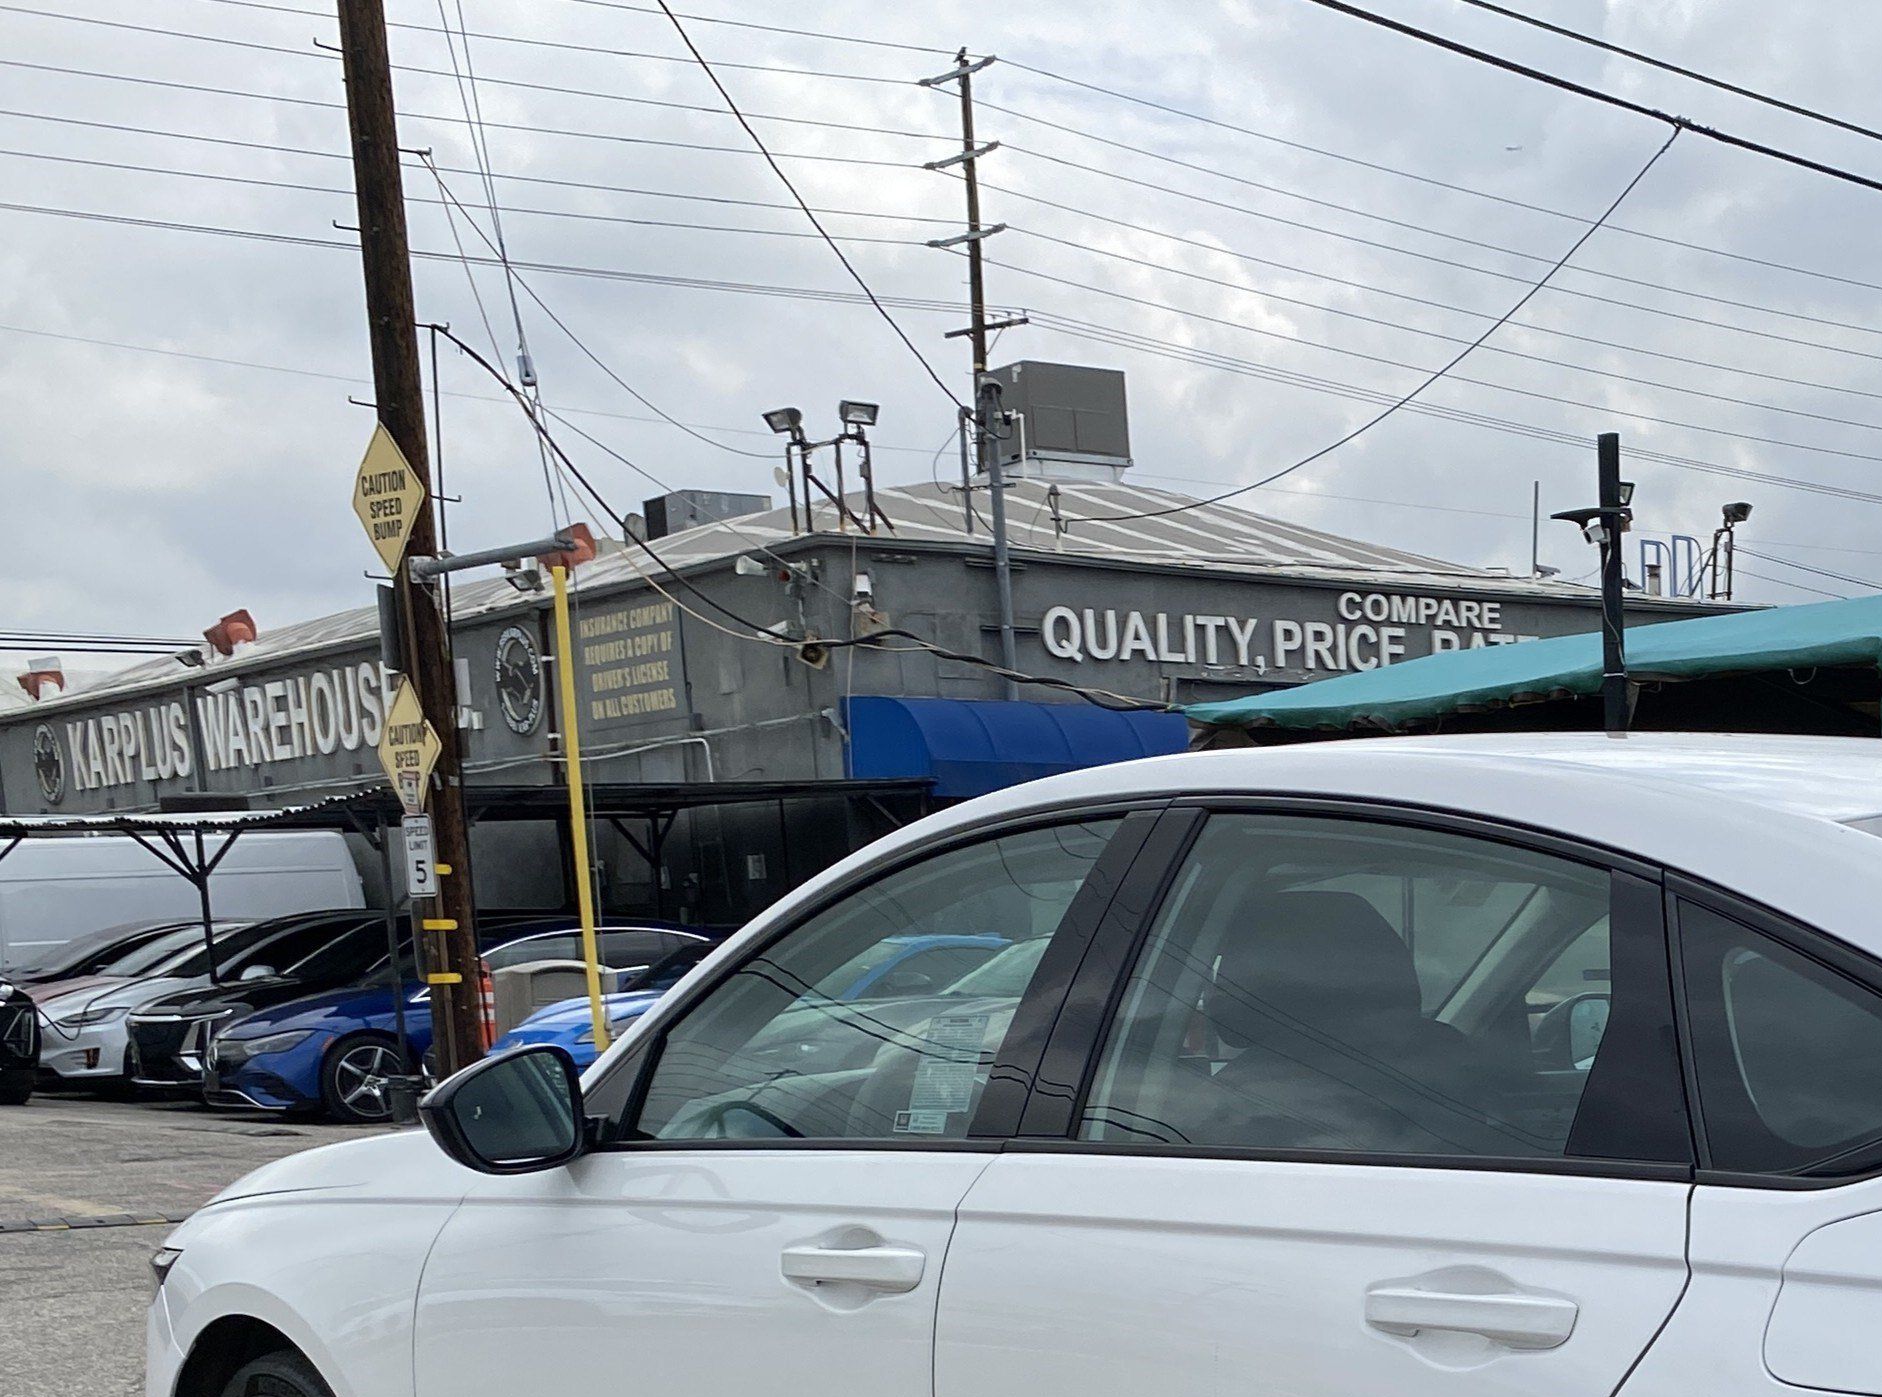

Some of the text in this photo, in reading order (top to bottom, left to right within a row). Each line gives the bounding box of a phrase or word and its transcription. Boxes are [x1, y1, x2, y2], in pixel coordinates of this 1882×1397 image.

[361, 469, 406, 497] CAUTION
[370, 497, 402, 519] SPEED
[373, 519, 403, 540] BUMP
[580, 602, 673, 639] INSURANCE COMPANY
[1337, 592, 1502, 629] COMPARE
[585, 631, 672, 666] REQUIRES A COPY OF
[1042, 605, 1264, 675] QUALITY,
[1272, 619, 1406, 672] PRICE
[593, 661, 669, 692] DRIVER'S LICENSE
[606, 698, 621, 717] ALL
[620, 688, 677, 715] CUSTOMERS
[66, 702, 192, 791] KARPLUS
[388, 723, 424, 746] CAUTION
[395, 749, 420, 768] SPEED
[405, 825, 429, 837] SPEED
[408, 839, 428, 851] LIMIT
[414, 860, 427, 884] 5
